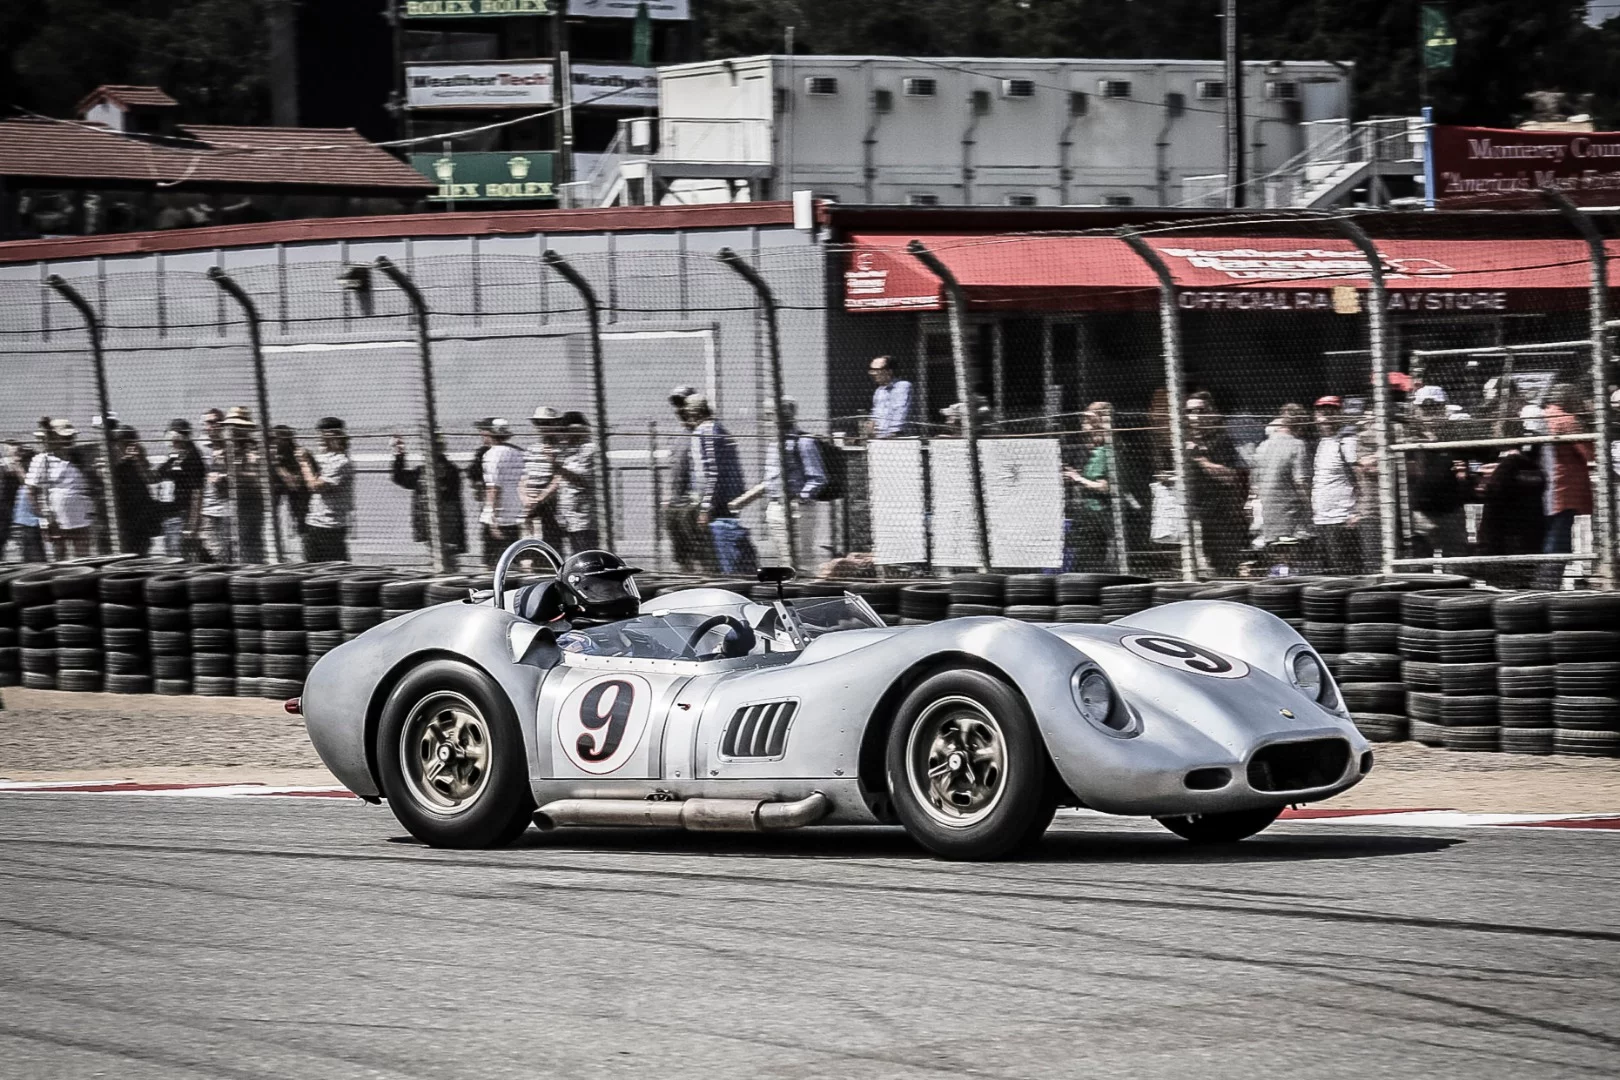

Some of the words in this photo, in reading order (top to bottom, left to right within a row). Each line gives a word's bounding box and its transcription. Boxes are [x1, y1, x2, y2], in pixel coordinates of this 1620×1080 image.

[407, 0, 474, 14] ROLEX
[480, 0, 549, 13] ROLEX
[485, 182, 553, 197] ROLEX
[1178, 291, 1292, 309] OFFICIAL
[1295, 292, 1423, 310] RAAY
[1425, 292, 1506, 310] STORE
[1134, 637, 1233, 673] 9
[576, 679, 635, 763] 9
